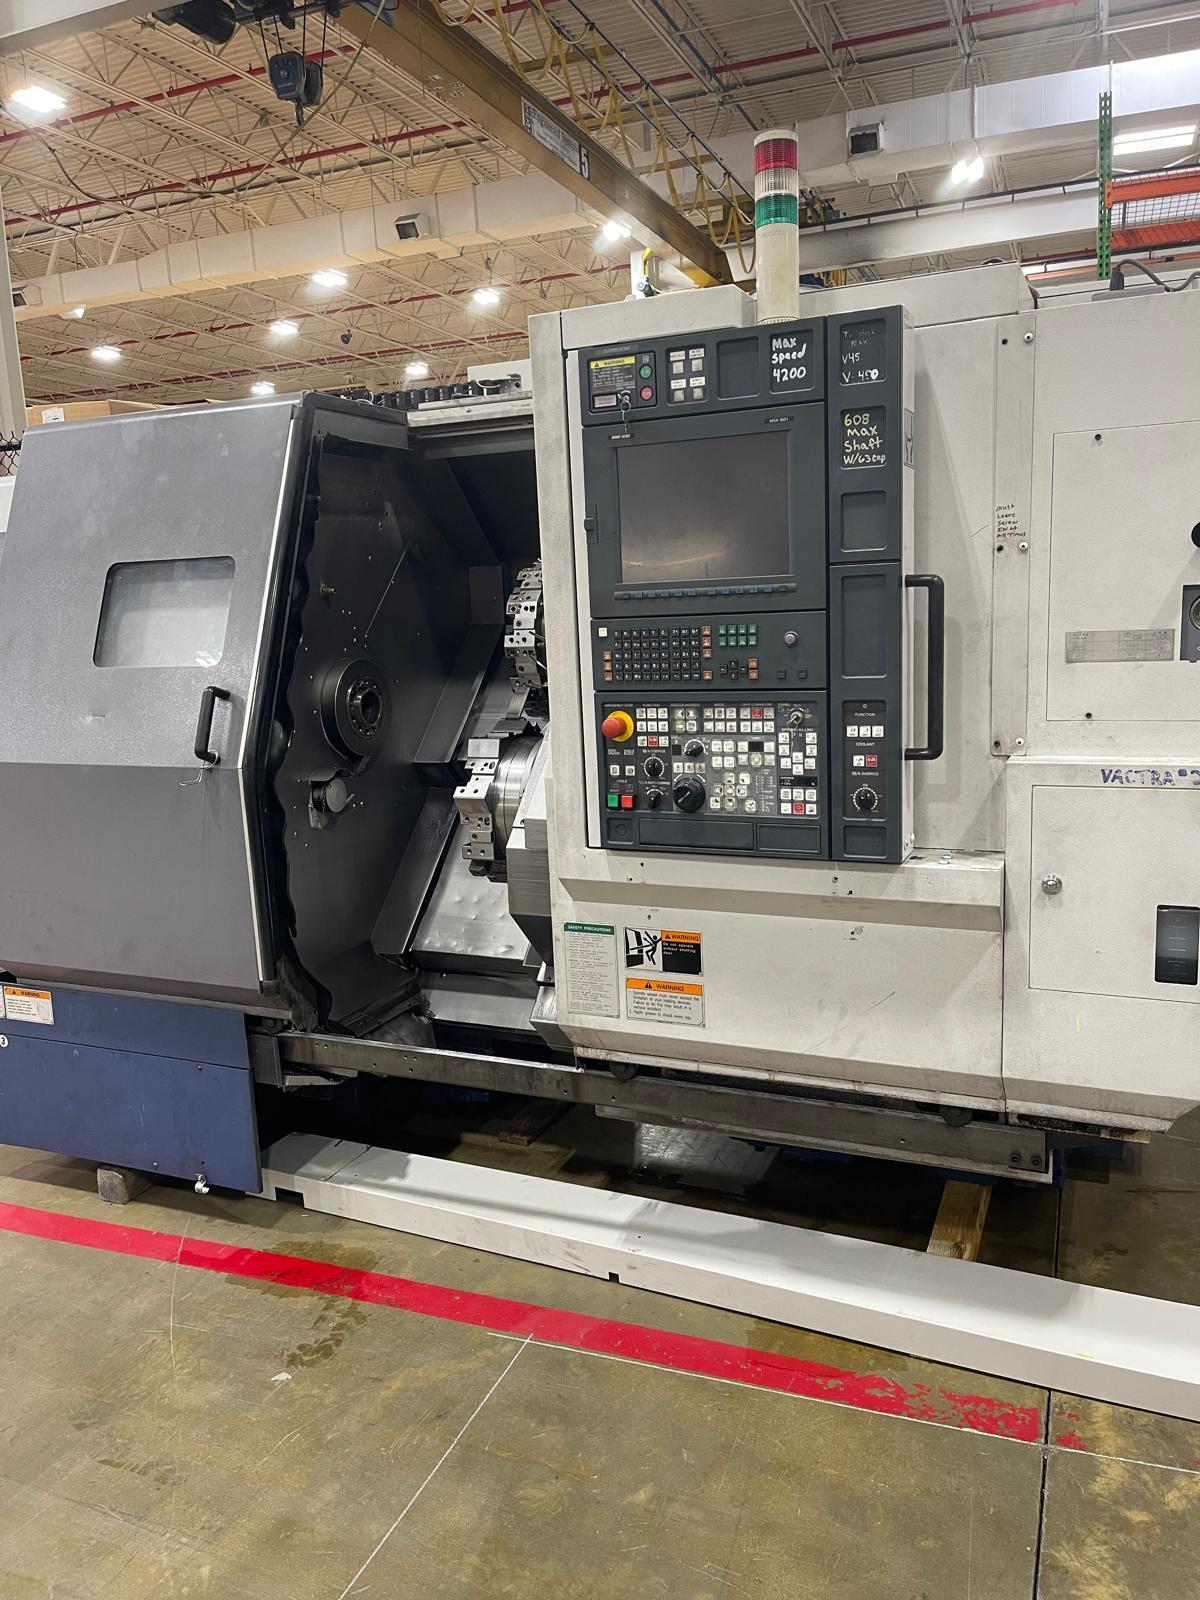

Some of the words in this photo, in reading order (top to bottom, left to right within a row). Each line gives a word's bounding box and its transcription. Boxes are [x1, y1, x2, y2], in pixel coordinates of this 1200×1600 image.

[773, 366, 807, 383] 4200
[844, 413, 870, 426] 608
[1100, 768, 1176, 786] VACTRA
[672, 934, 699, 942] WARNING
[656, 983, 684, 991] WARNING
